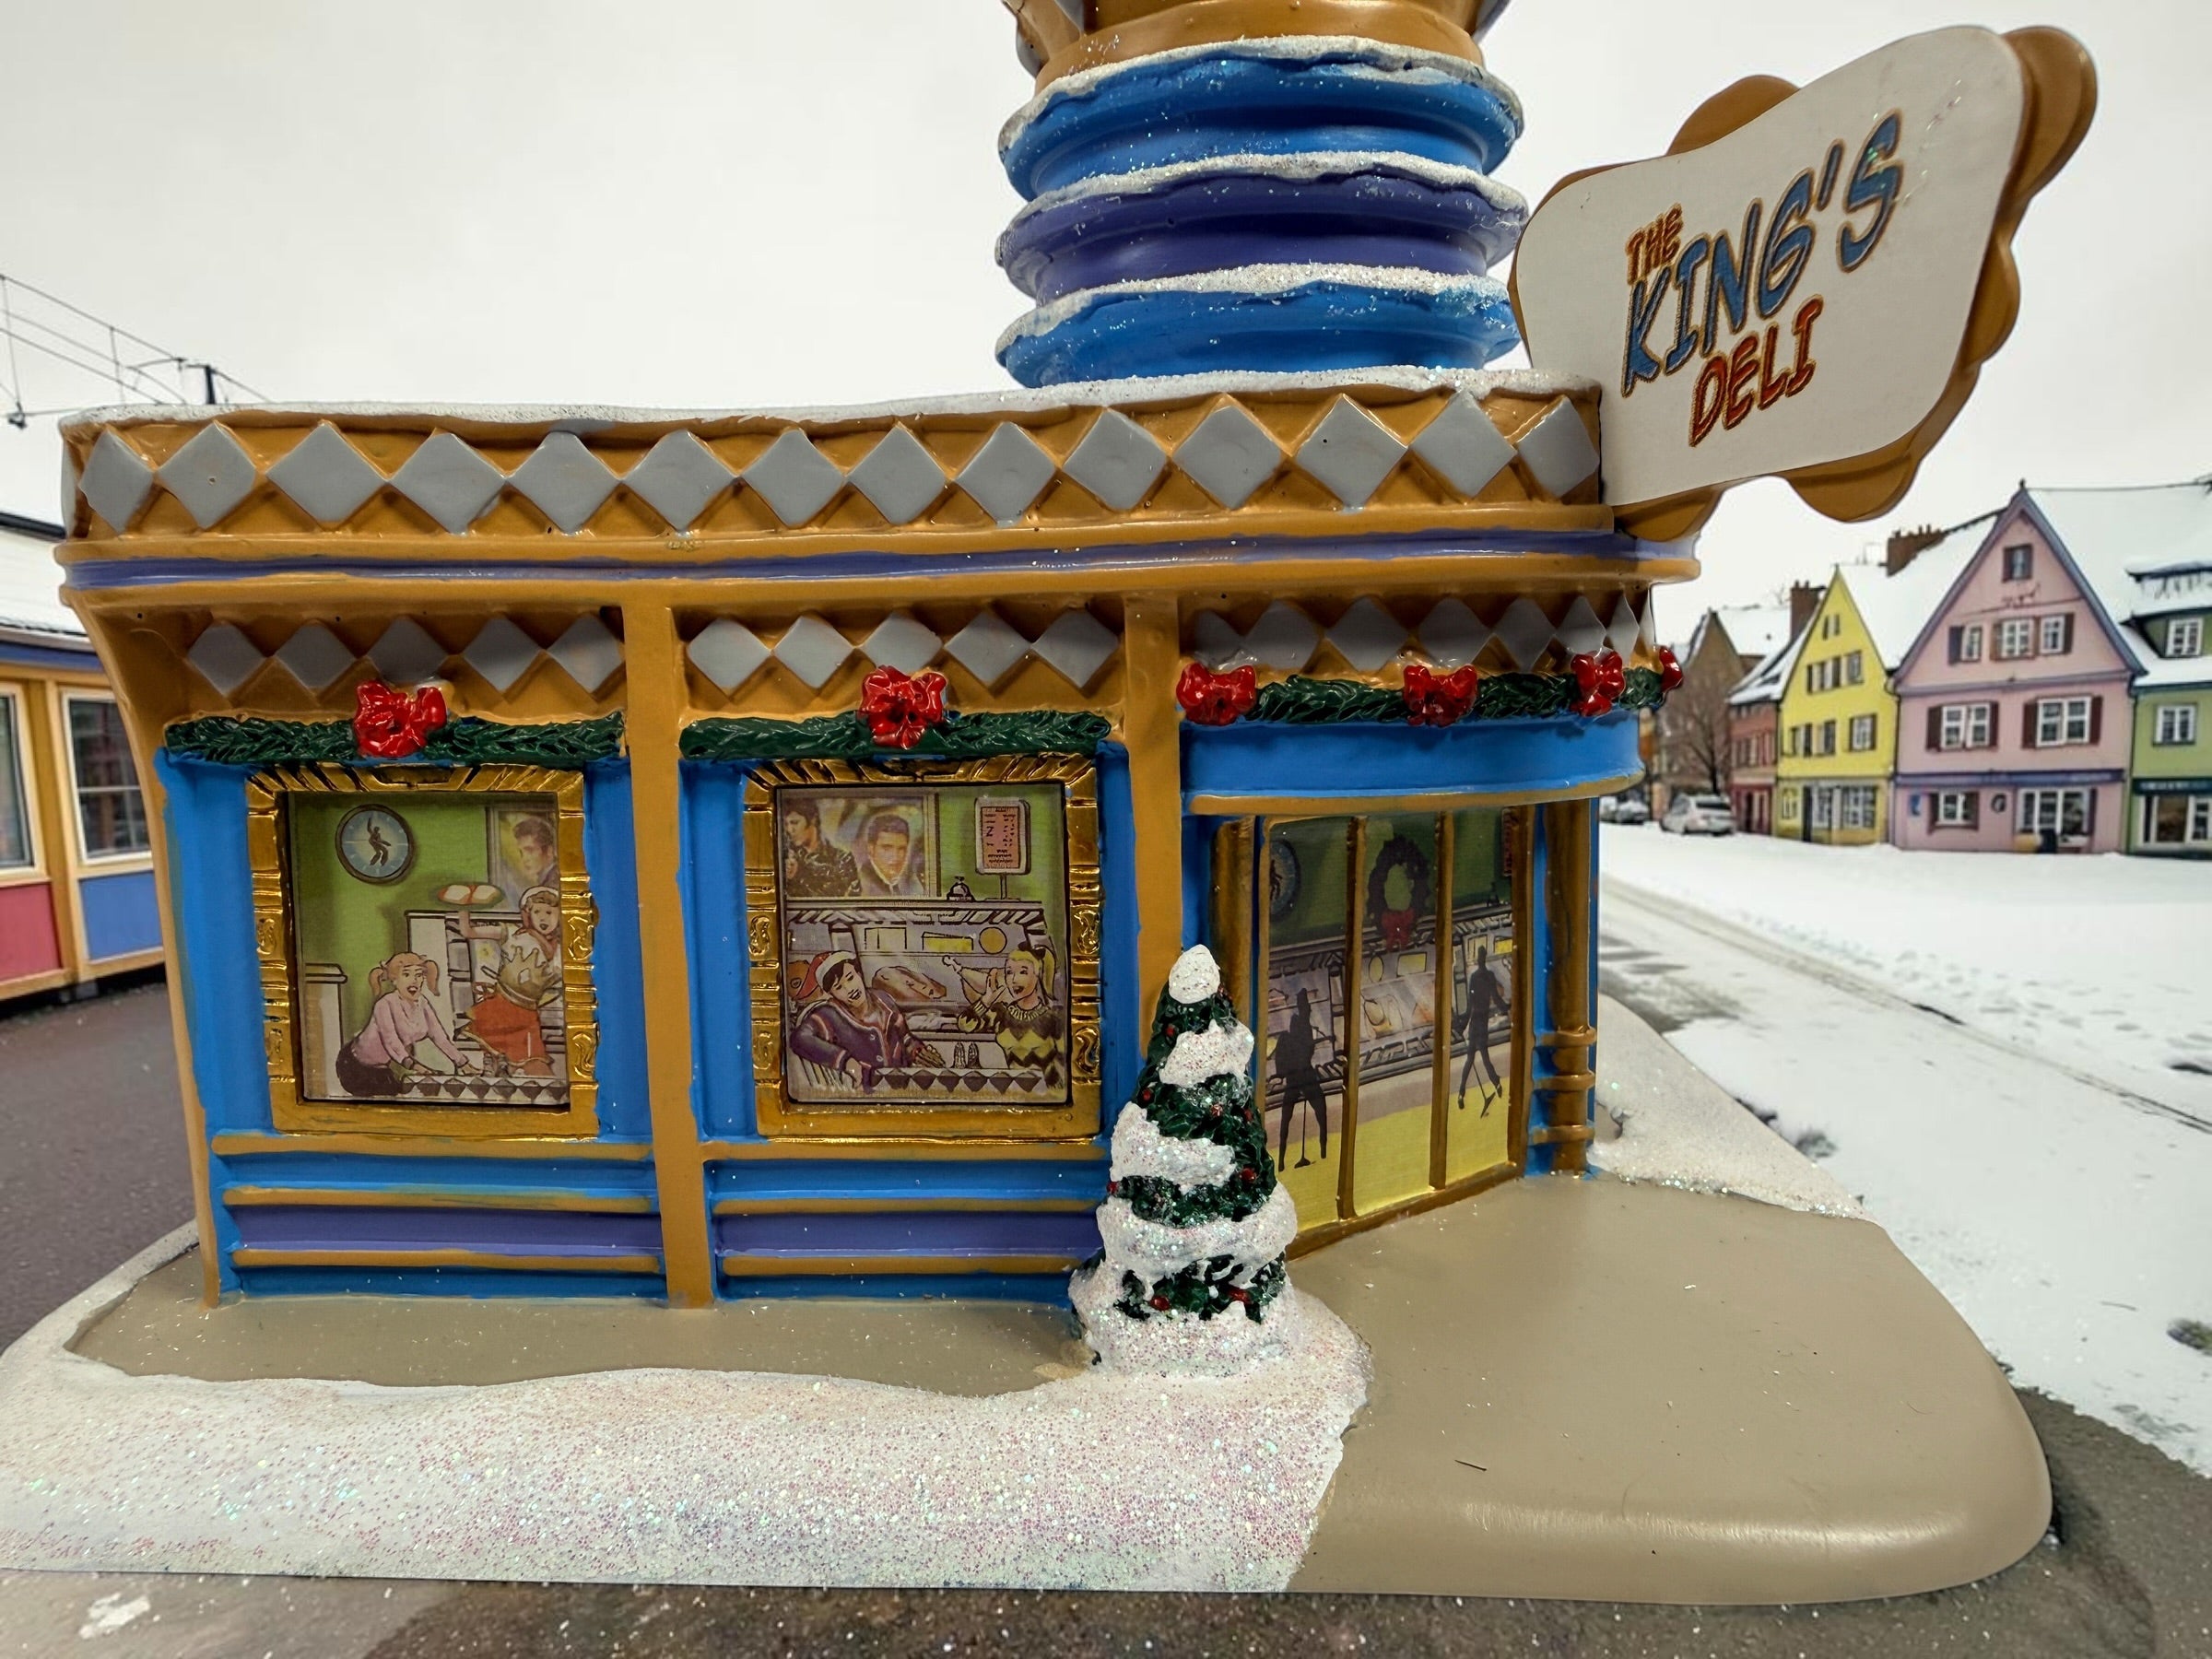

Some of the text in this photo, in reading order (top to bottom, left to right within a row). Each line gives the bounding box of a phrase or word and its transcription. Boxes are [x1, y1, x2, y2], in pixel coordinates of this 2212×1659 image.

[1621, 109, 1904, 398] KING'S
[1626, 204, 1684, 286] THE
[1689, 295, 1824, 447] DELI
